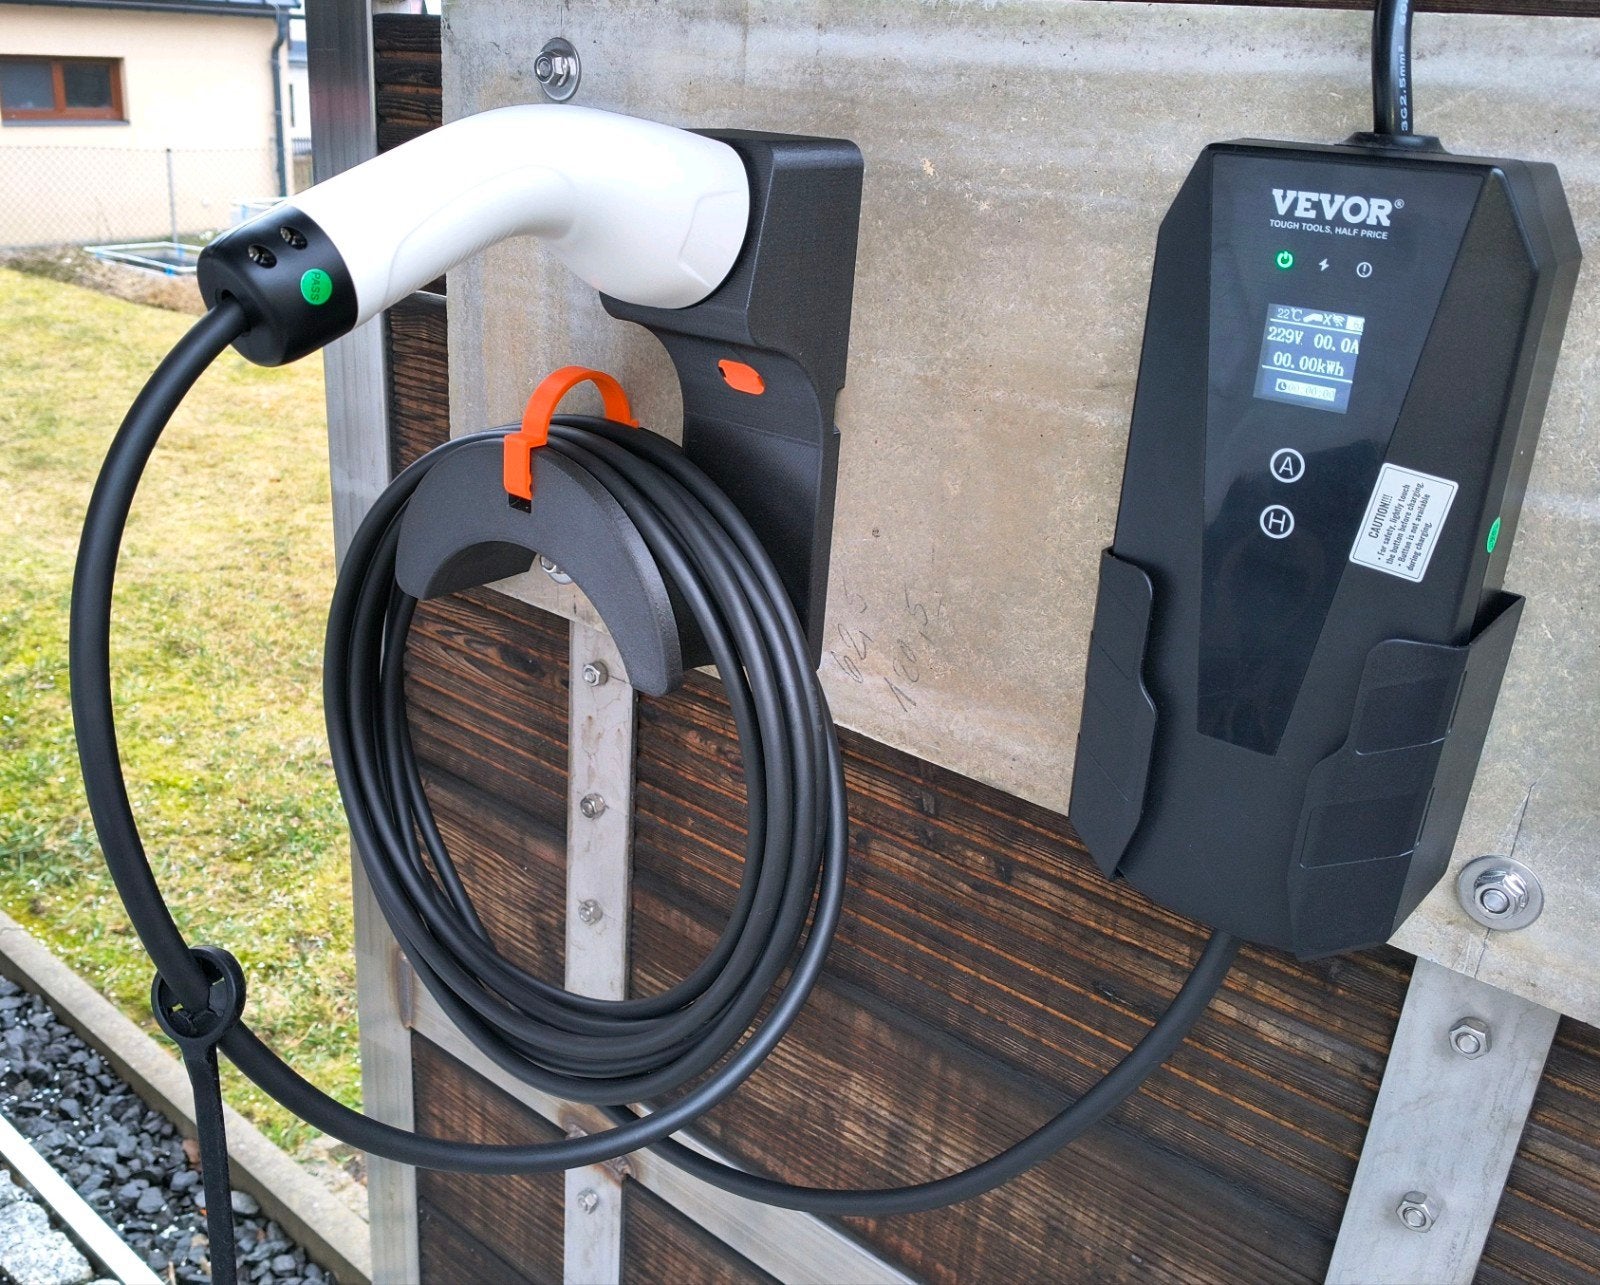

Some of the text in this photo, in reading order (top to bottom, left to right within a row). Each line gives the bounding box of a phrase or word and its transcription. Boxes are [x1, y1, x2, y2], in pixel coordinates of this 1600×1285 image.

[1269, 219, 1388, 240] TOUGH TOOLS, HALF PRICE
[311, 271, 321, 301] PASS
[1267, 326, 1304, 344] 229V
[1368, 494, 1393, 539] CAUTION!!!
[1378, 485, 1410, 556] For safety, lightly touch
[1386, 482, 1425, 565] the button before charging.
[1399, 542, 1412, 563] Button
[1410, 523, 1419, 534] not
[1415, 494, 1430, 522] available
[1407, 522, 1433, 571] during charging.
